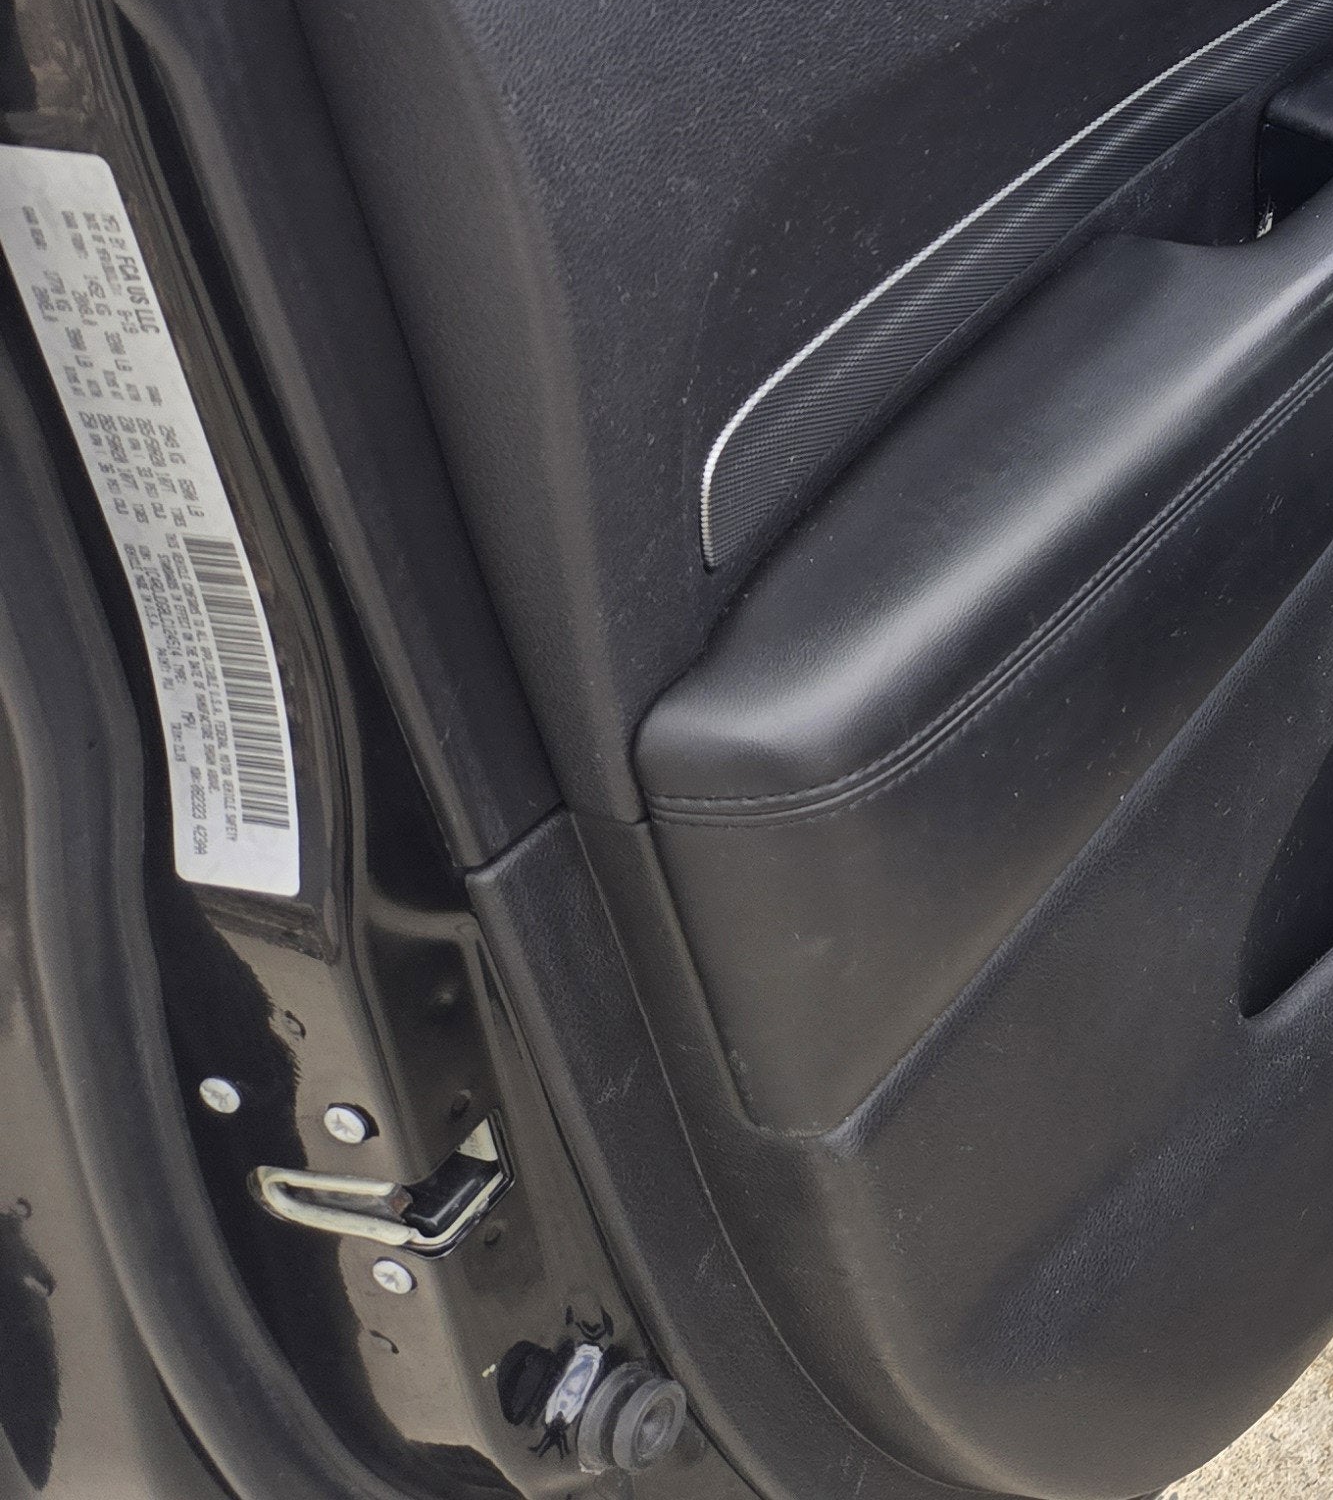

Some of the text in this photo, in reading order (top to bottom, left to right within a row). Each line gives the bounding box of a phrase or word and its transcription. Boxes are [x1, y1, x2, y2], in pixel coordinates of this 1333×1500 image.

[116, 254, 141, 281] FCA
[127, 286, 150, 305] US
[135, 309, 160, 334] LLC
[75, 355, 94, 368] LB
[114, 359, 132, 372] LB
[187, 505, 205, 517] LB
[181, 710, 197, 729] MPV
[225, 813, 239, 842] SAFETY
